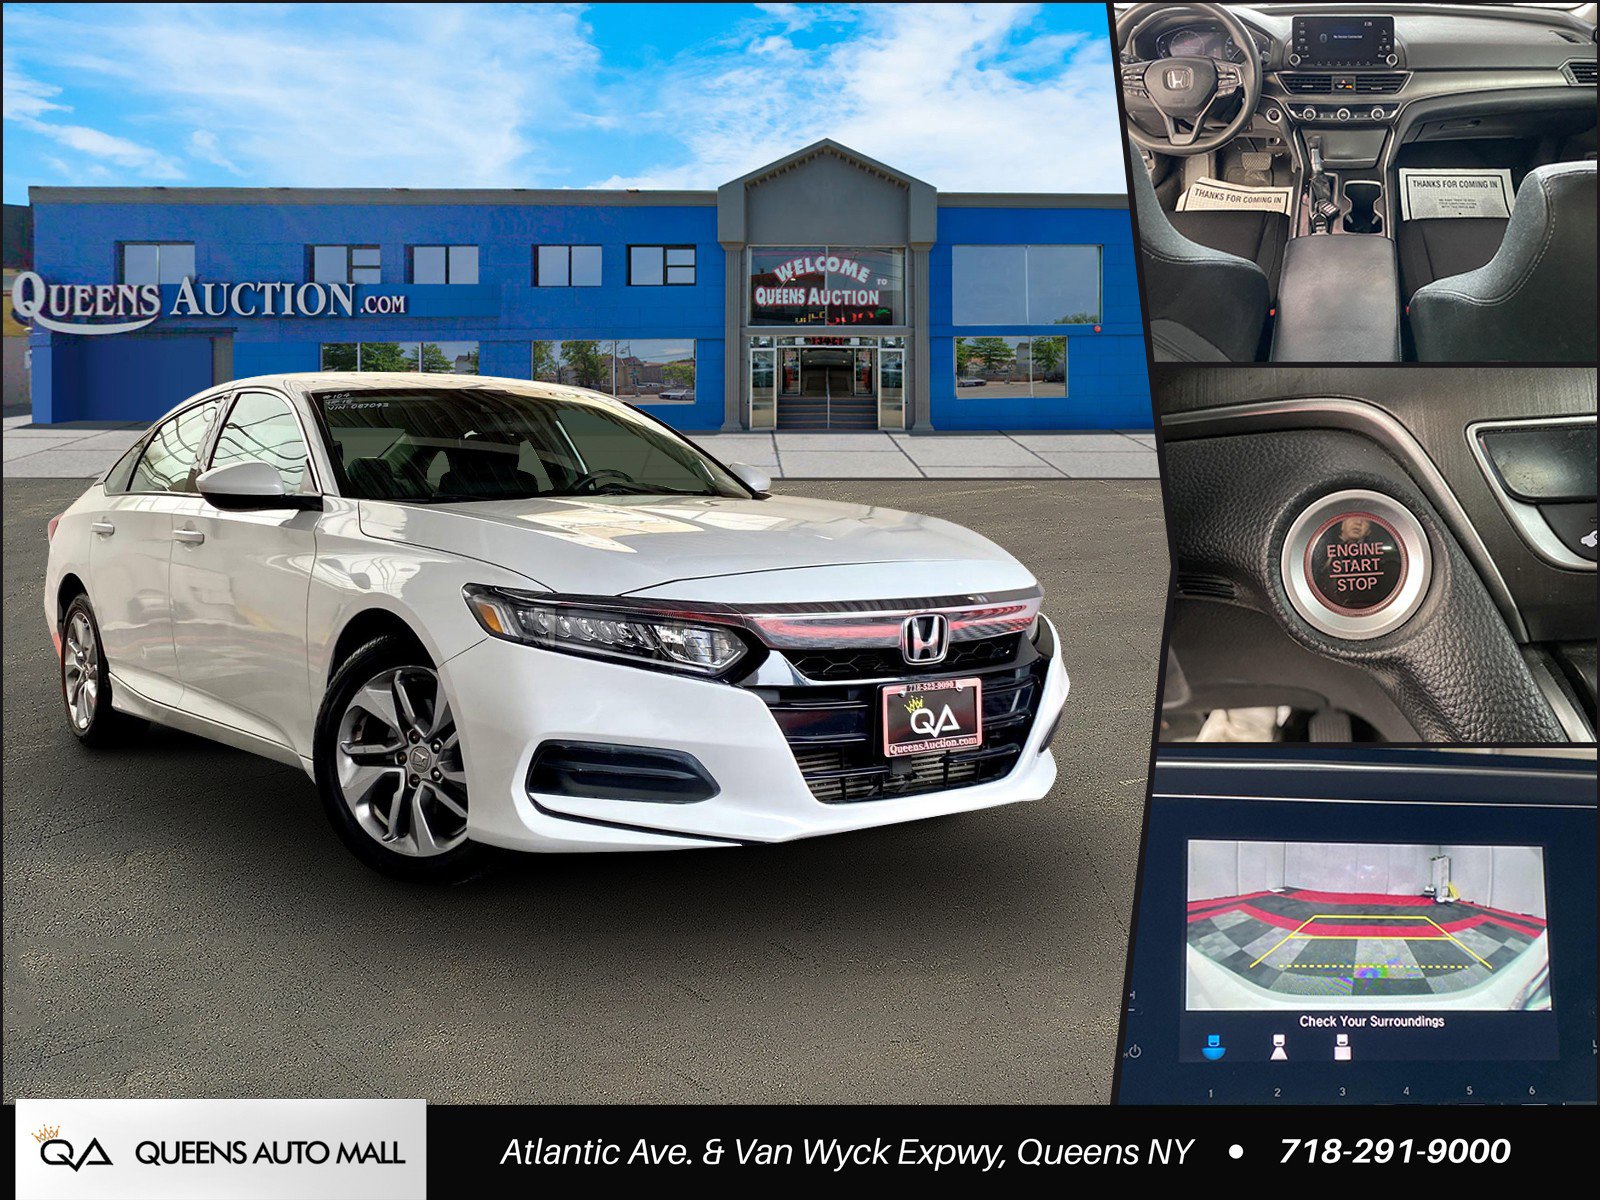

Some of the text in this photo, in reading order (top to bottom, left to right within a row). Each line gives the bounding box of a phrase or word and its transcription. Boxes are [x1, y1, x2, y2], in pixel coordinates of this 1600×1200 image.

[1412, 180, 1498, 189] THANKS FOR COMING IN
[1194, 188, 1282, 204] THANKS FOR COMING IN
[773, 256, 888, 286] WELCOME TO
[12, 271, 161, 335] QUEENS
[755, 287, 880, 307] QUEENS AUCTION
[1327, 542, 1384, 557] ENGINE
[1332, 558, 1380, 573] START
[1337, 577, 1377, 592] STOP
[910, 704, 960, 738] QA
[889, 736, 977, 755] QueensAuction.com
[1299, 1014, 1445, 1029] Check Your Surroundings
[1207, 1086, 1536, 1098] 1 2 3 4 5 6
